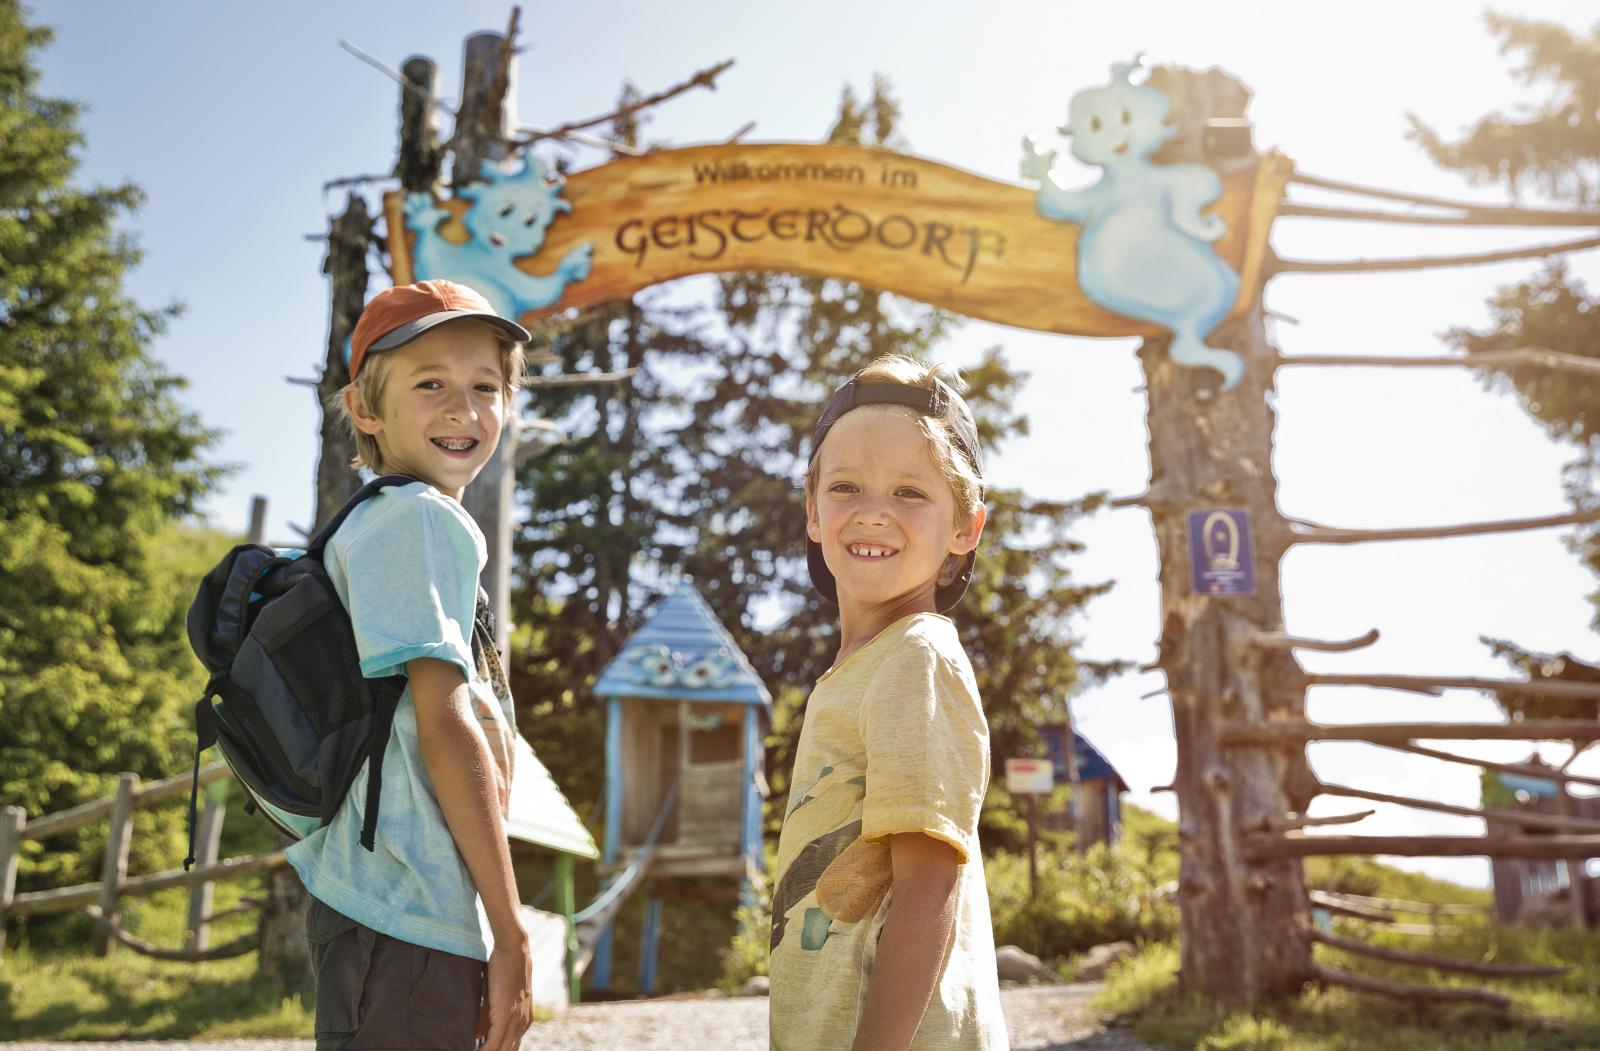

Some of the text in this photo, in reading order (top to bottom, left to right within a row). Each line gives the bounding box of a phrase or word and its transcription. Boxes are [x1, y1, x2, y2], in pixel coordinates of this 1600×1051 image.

[693, 161, 917, 188] Willkommen im
[615, 204, 1006, 285] GEISTERDORF
